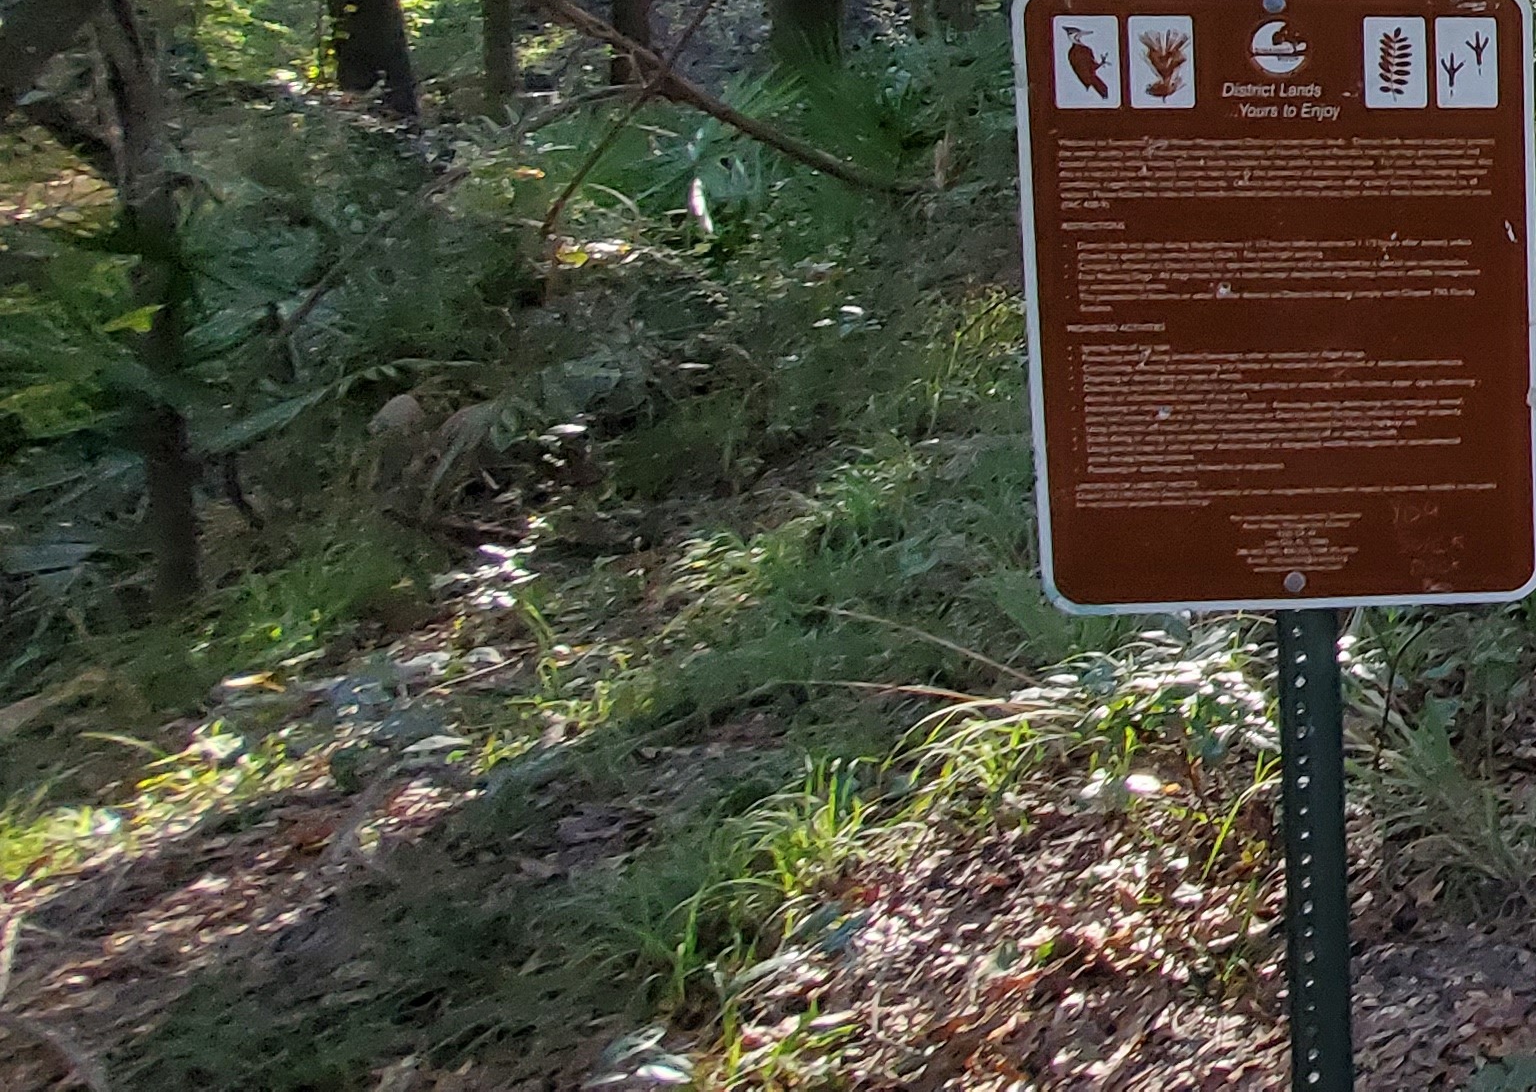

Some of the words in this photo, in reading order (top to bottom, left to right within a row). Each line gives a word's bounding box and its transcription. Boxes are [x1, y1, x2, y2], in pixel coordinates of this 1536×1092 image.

[1222, 82, 1275, 98] District
[1279, 82, 1322, 98] Lands
[1283, 103, 1297, 118] to
[1301, 102, 1341, 121] Enjoy
